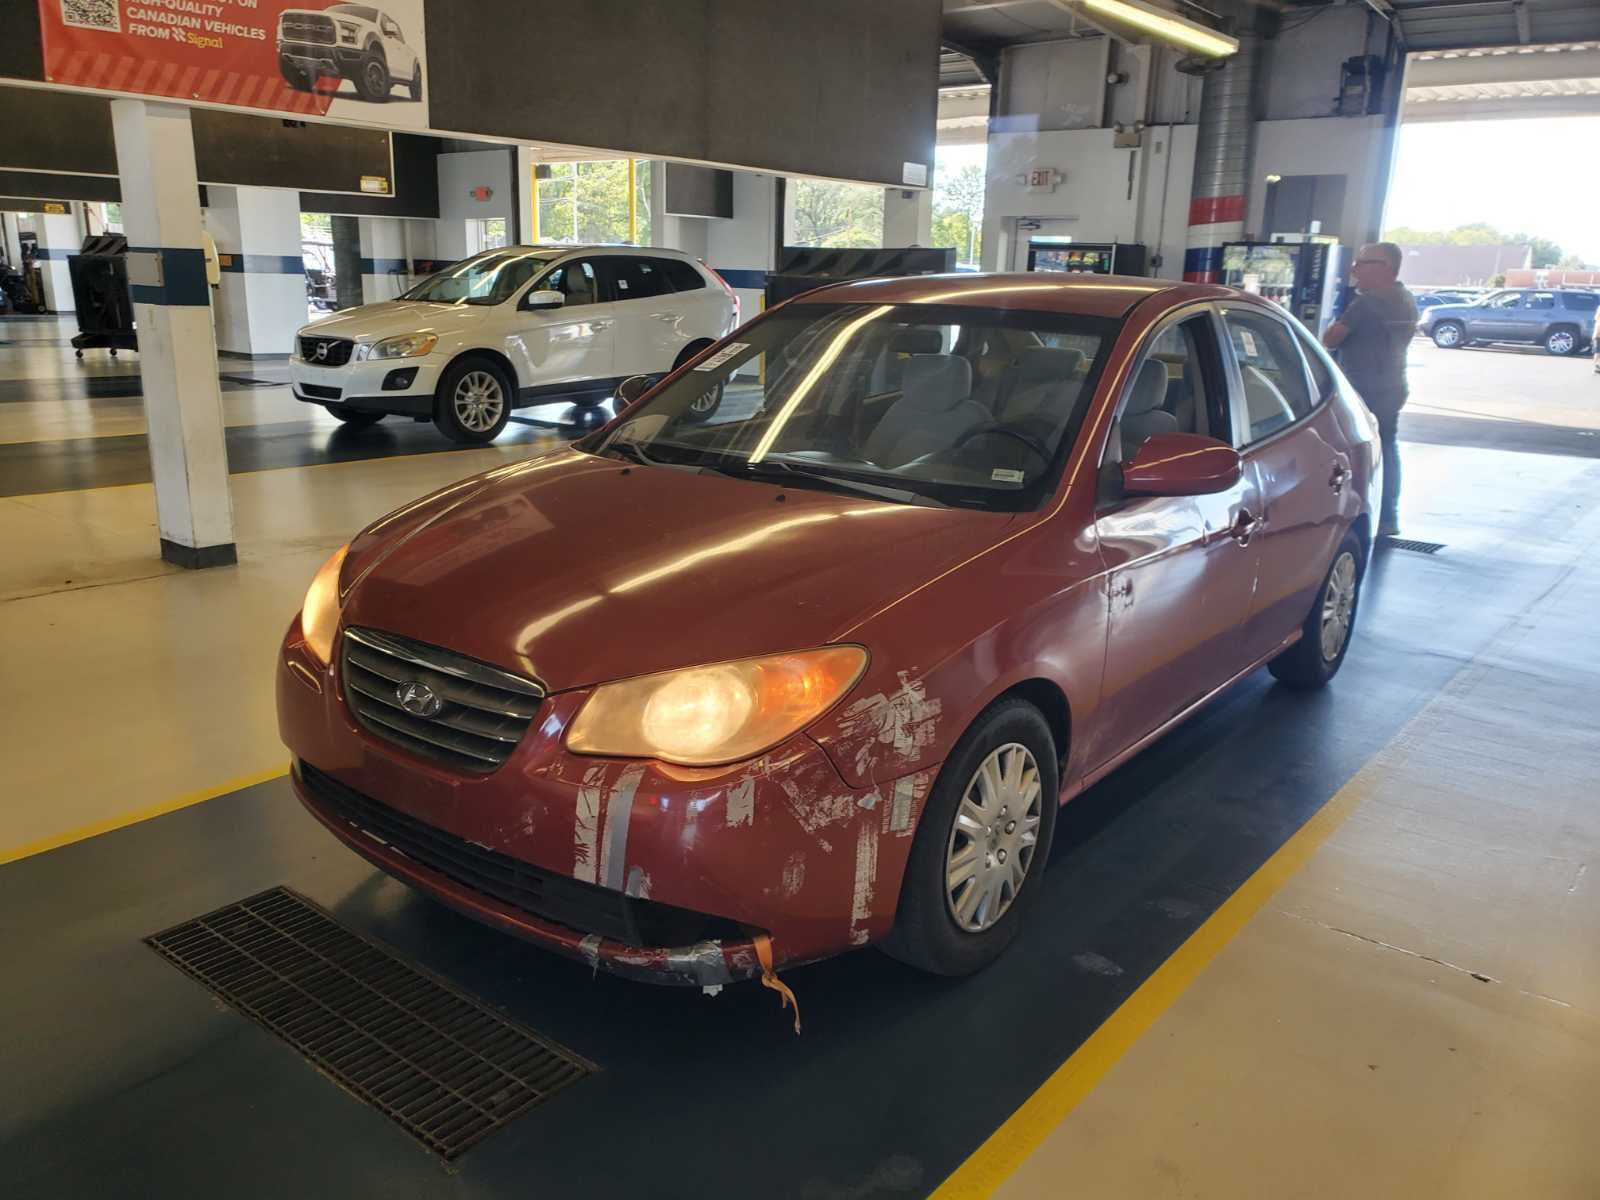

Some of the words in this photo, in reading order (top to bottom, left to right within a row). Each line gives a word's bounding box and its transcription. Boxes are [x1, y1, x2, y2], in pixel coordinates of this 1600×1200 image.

[126, 7, 200, 29] CANADIAN
[204, 20, 267, 40] VEHICLES
[128, 24, 170, 40] FROM
[187, 32, 223, 48] Signal
